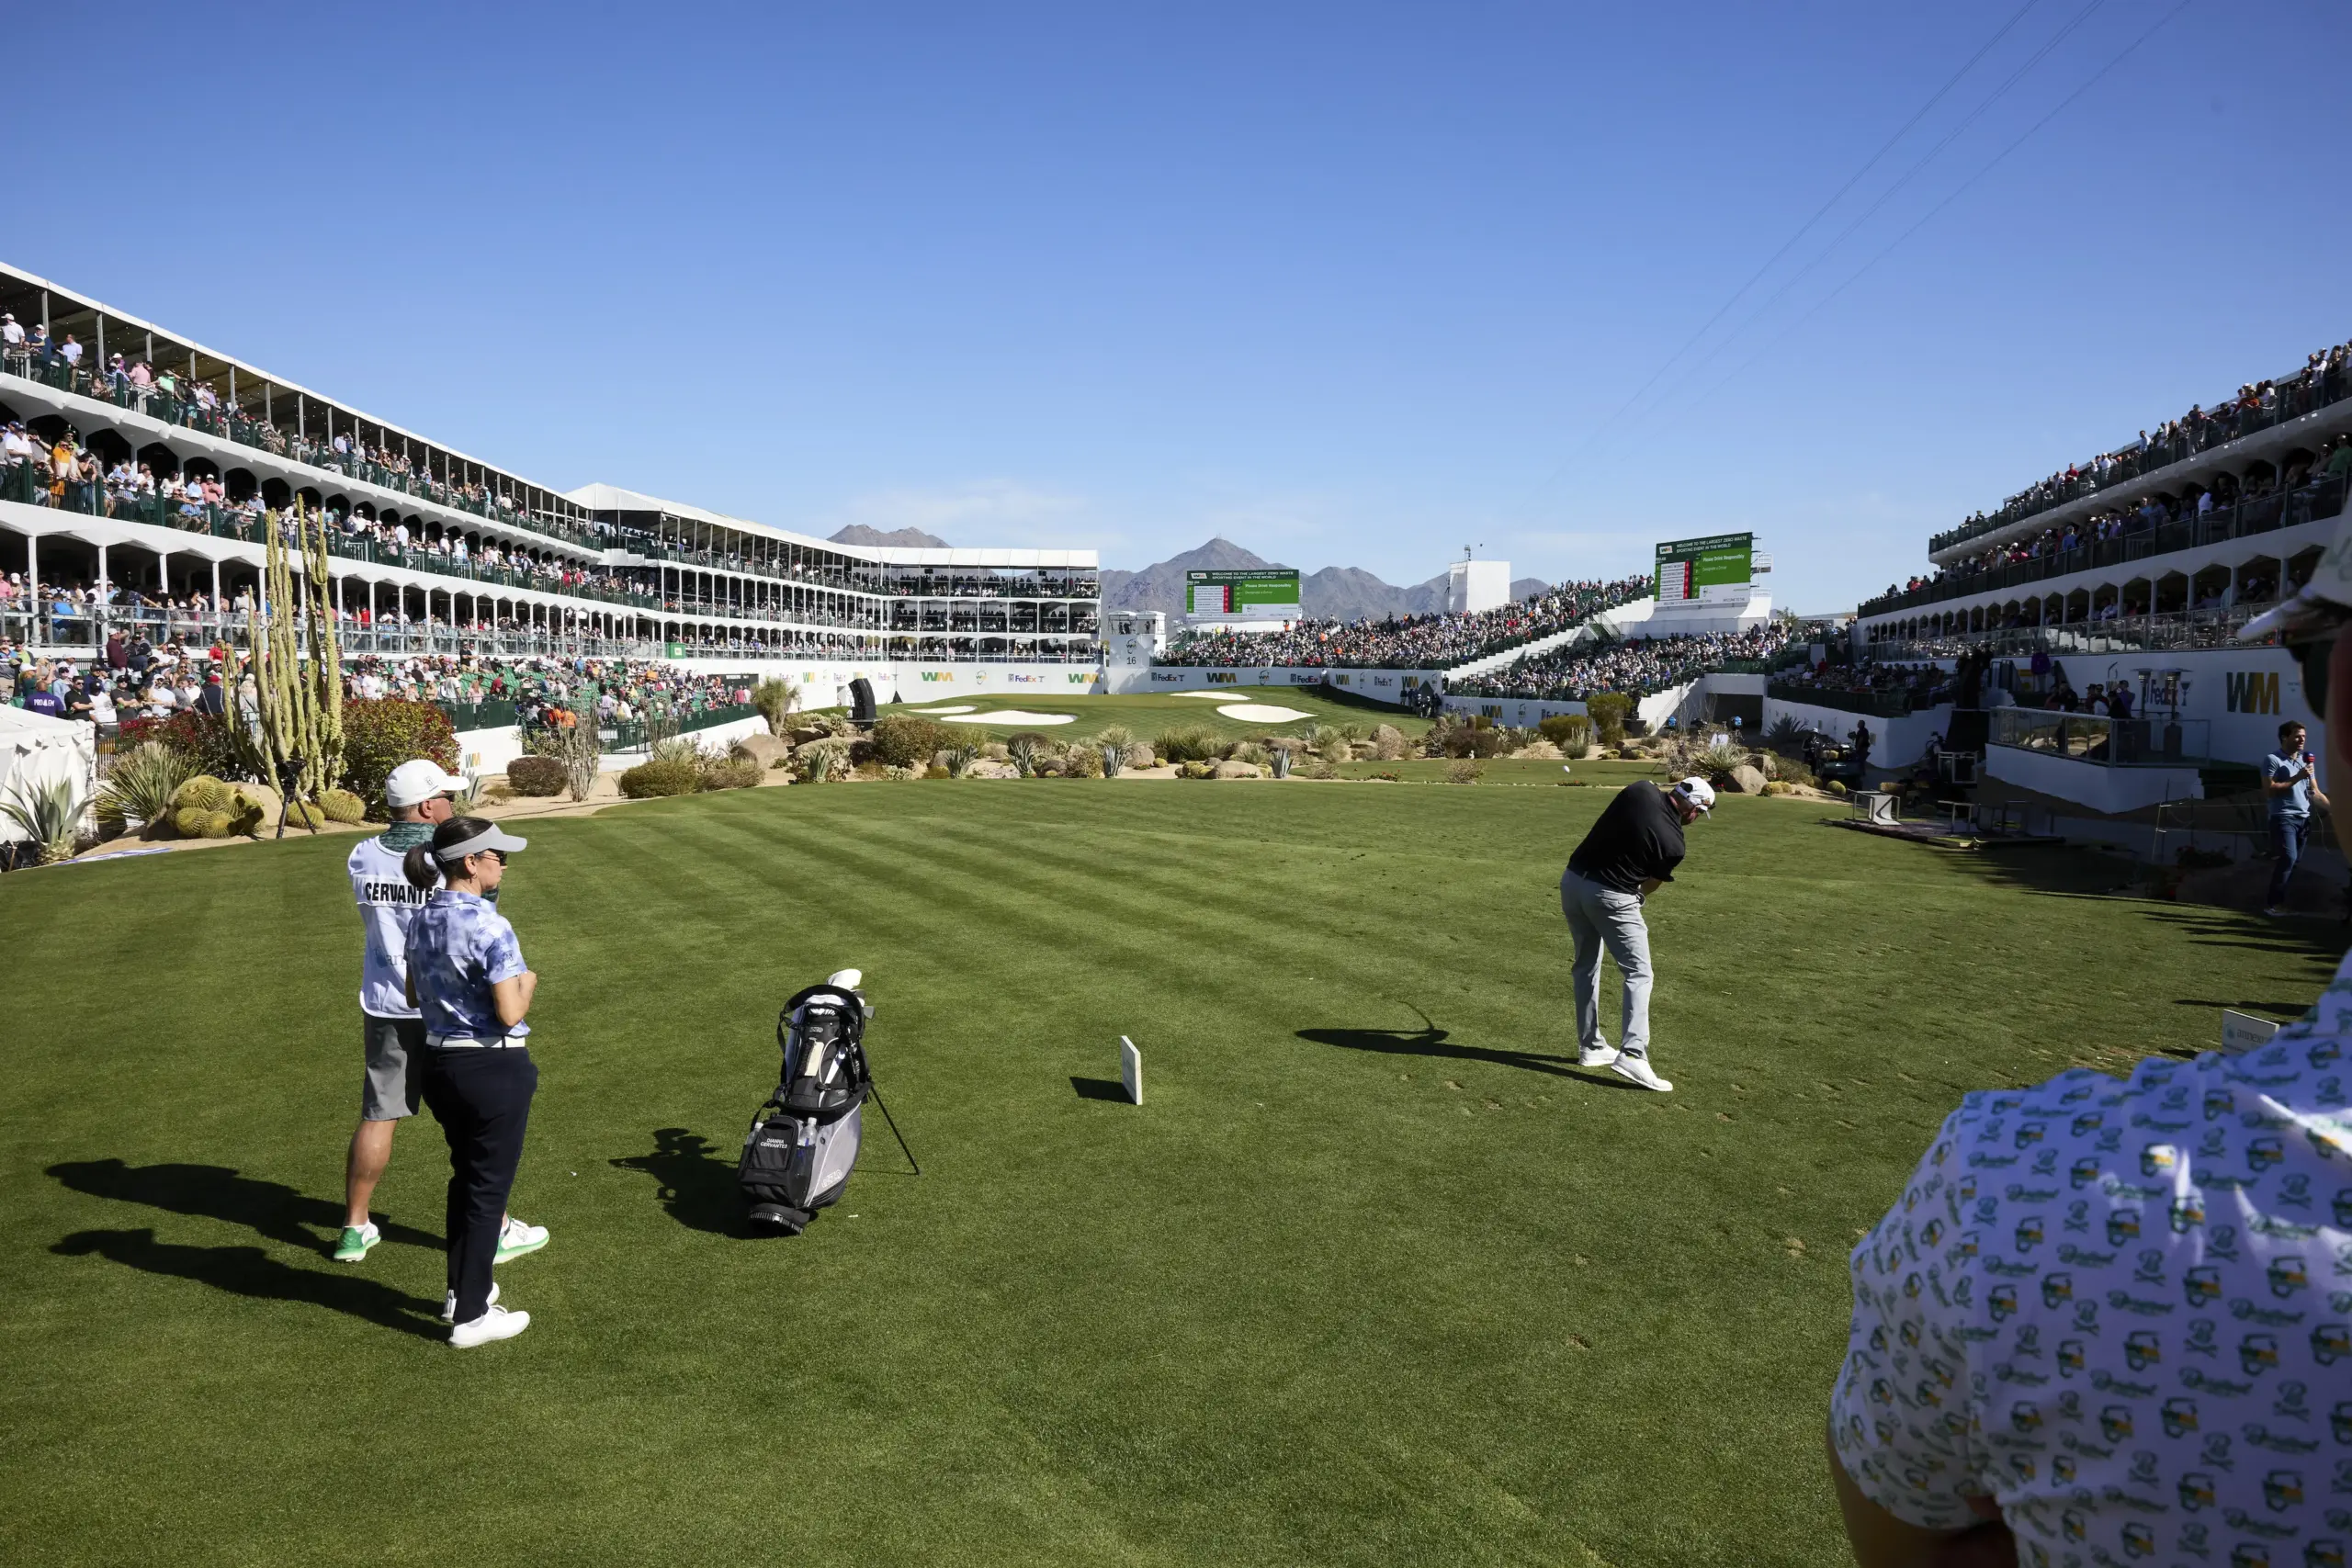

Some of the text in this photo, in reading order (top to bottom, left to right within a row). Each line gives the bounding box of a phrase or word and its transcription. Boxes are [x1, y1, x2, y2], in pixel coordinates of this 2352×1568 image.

[1126, 656, 1136, 664] 16
[803, 671, 815, 682] WM
[922, 671, 954, 682] WM
[1068, 673, 1100, 683] WM
[1158, 673, 1177, 682] FedEx
[1206, 672, 1237, 683] WM
[1296, 675, 1318, 683] FedEx
[1336, 674, 1350, 685] WM
[1402, 676, 1419, 688] WM
[2226, 671, 2278, 715] WM
[1482, 705, 1503, 718] WM
[465, 752, 481, 768] WM
[365, 882, 435, 904] CERVANTE
[760, 1141, 788, 1149] CERVANTES
